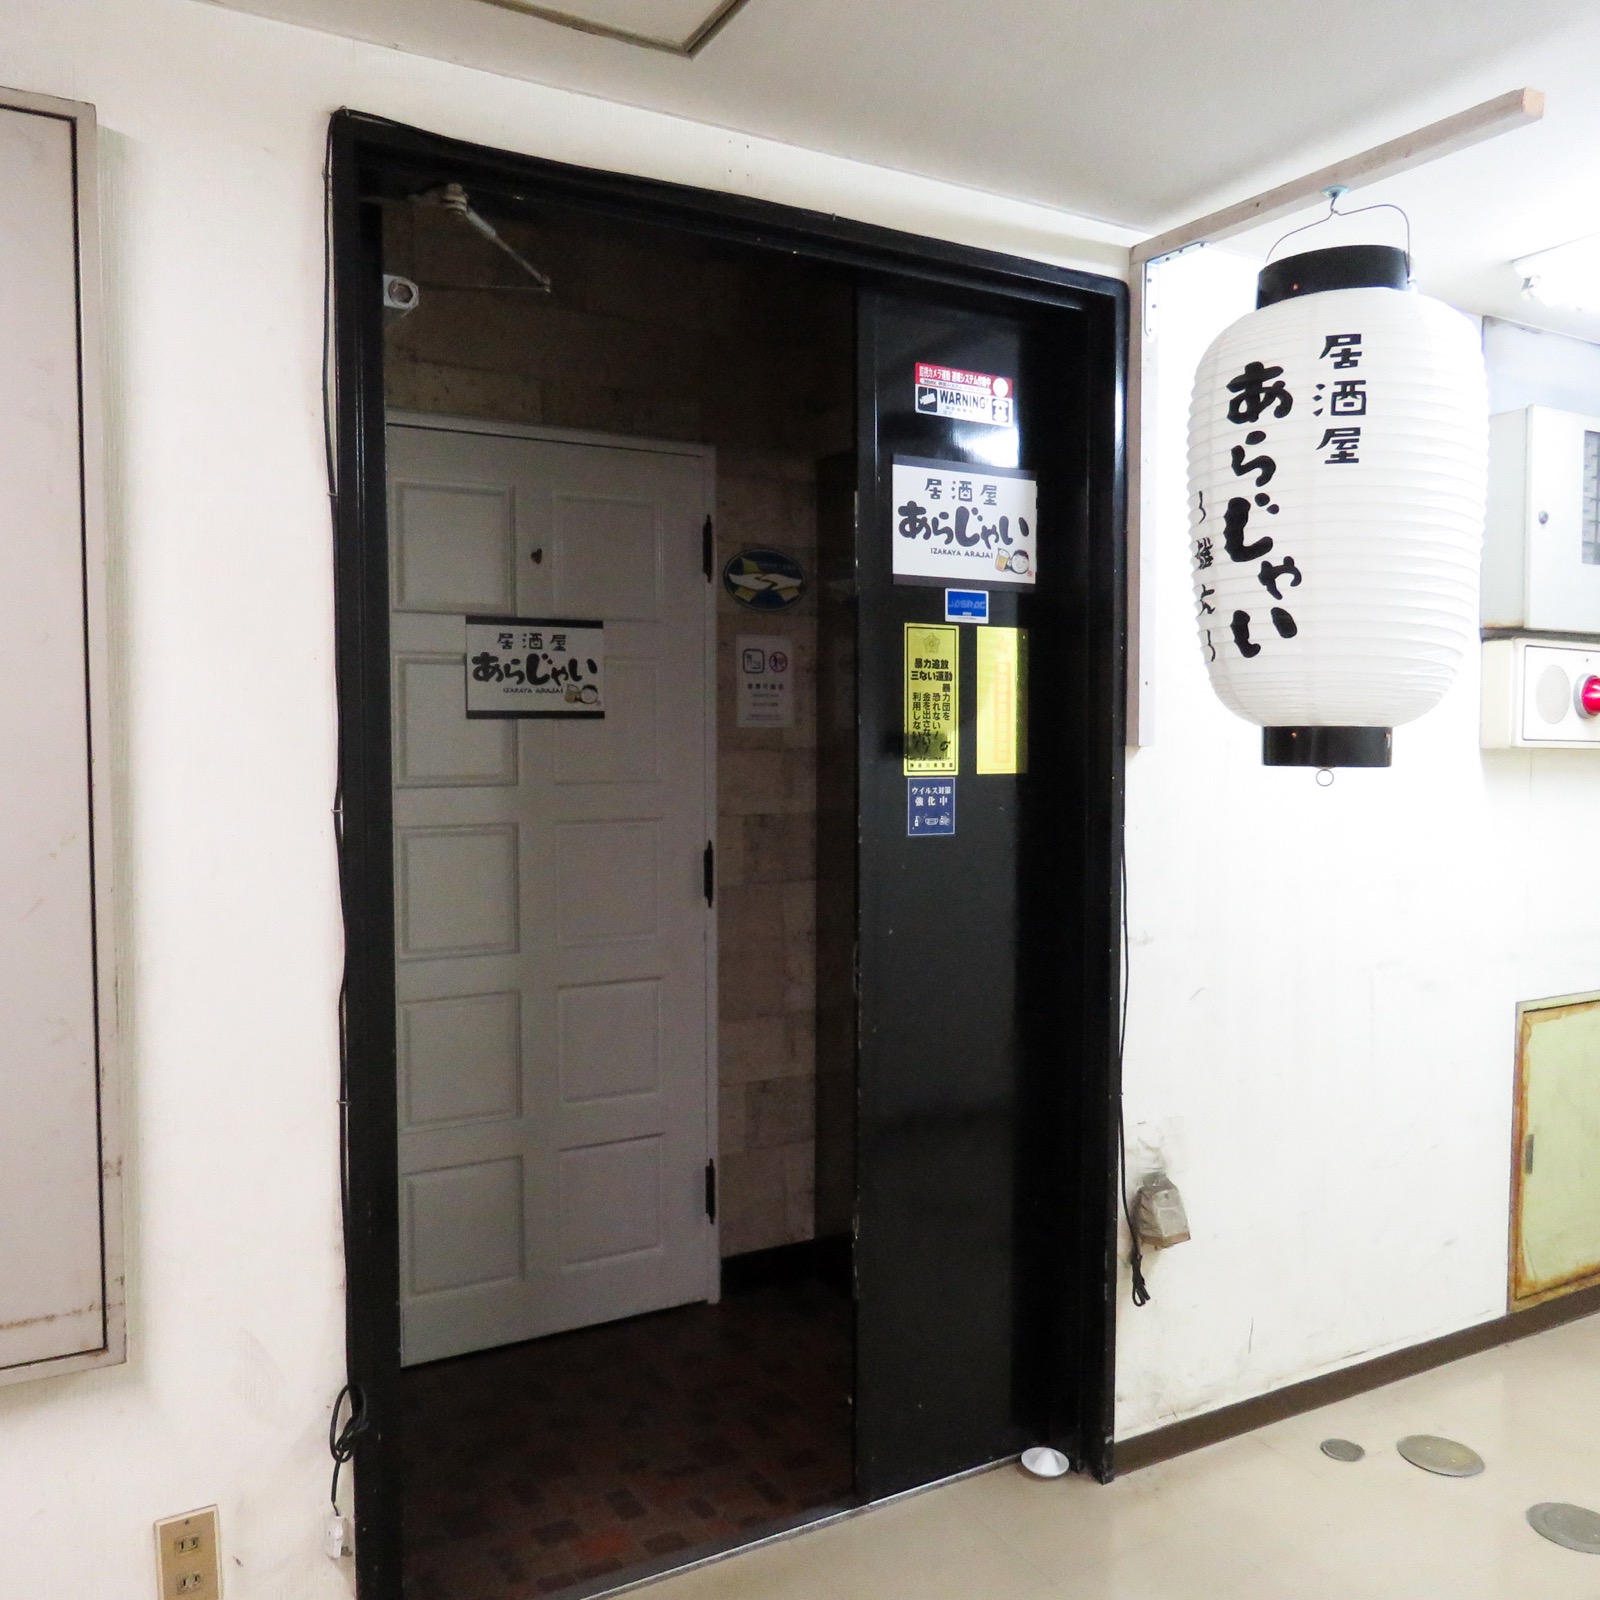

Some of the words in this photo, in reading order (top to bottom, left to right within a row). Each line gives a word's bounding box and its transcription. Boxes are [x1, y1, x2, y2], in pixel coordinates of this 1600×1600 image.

[1313, 333, 1367, 465] 居酒屋
[925, 477, 998, 507] 居酒屋
[1224, 361, 1302, 658] あらじゃい
[897, 500, 1030, 550] あらじゃい
[930, 547, 962, 557] IZAKAYA
[964, 549, 994, 559] ARAJAI
[497, 632, 567, 652] 居酒屋
[471, 651, 598, 687] あらじゃい
[910, 670, 953, 682] 三ない運動
[914, 658, 950, 670] 暴力追放
[942, 683, 951, 721] 暴力団を
[911, 786, 951, 795] ウイルス対策
[914, 795, 948, 807] 強化中
